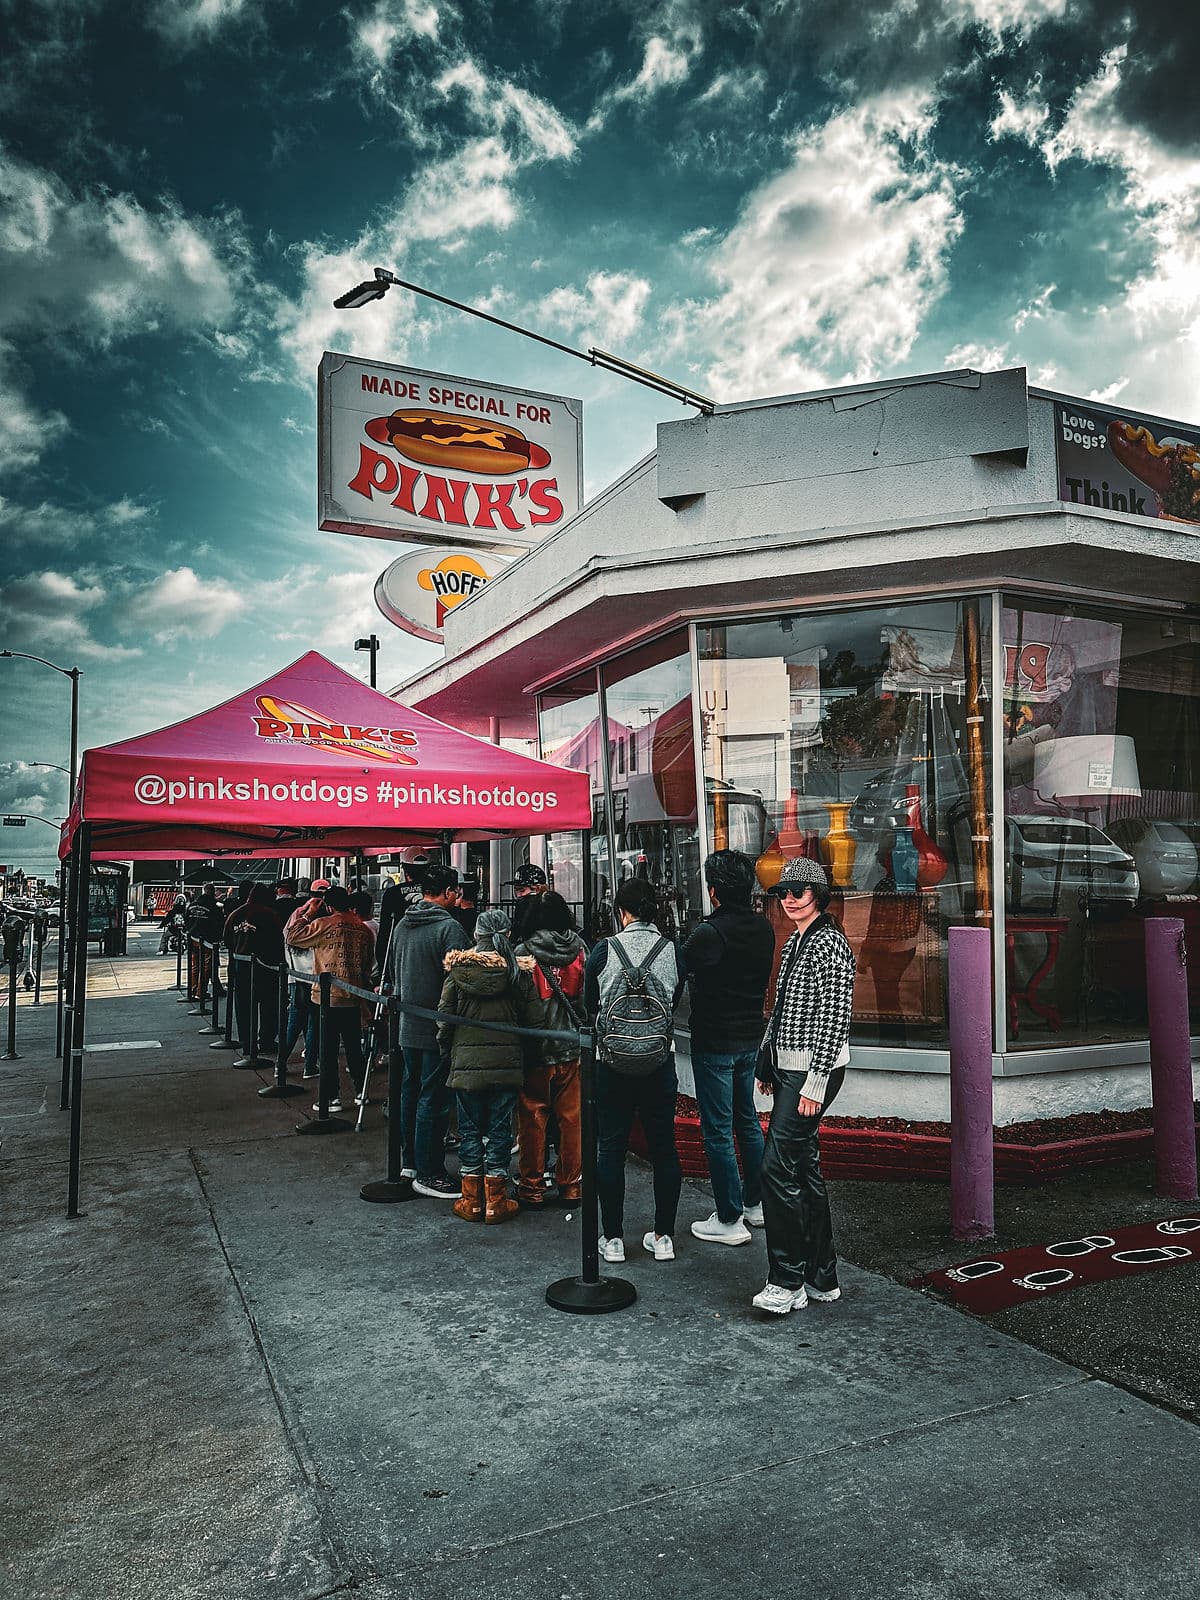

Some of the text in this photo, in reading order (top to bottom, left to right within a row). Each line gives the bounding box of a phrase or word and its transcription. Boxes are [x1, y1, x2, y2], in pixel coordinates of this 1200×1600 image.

[361, 374, 552, 425] MADE SPECIAL FOR
[1061, 411, 1096, 431] Love
[1063, 427, 1107, 450] Dogs?
[347, 442, 564, 532] PINK'S
[1065, 477, 1147, 515] Think
[254, 717, 418, 746] PINK'S
[134, 774, 558, 812] @pinkshotdogs #pinkshotdogs
